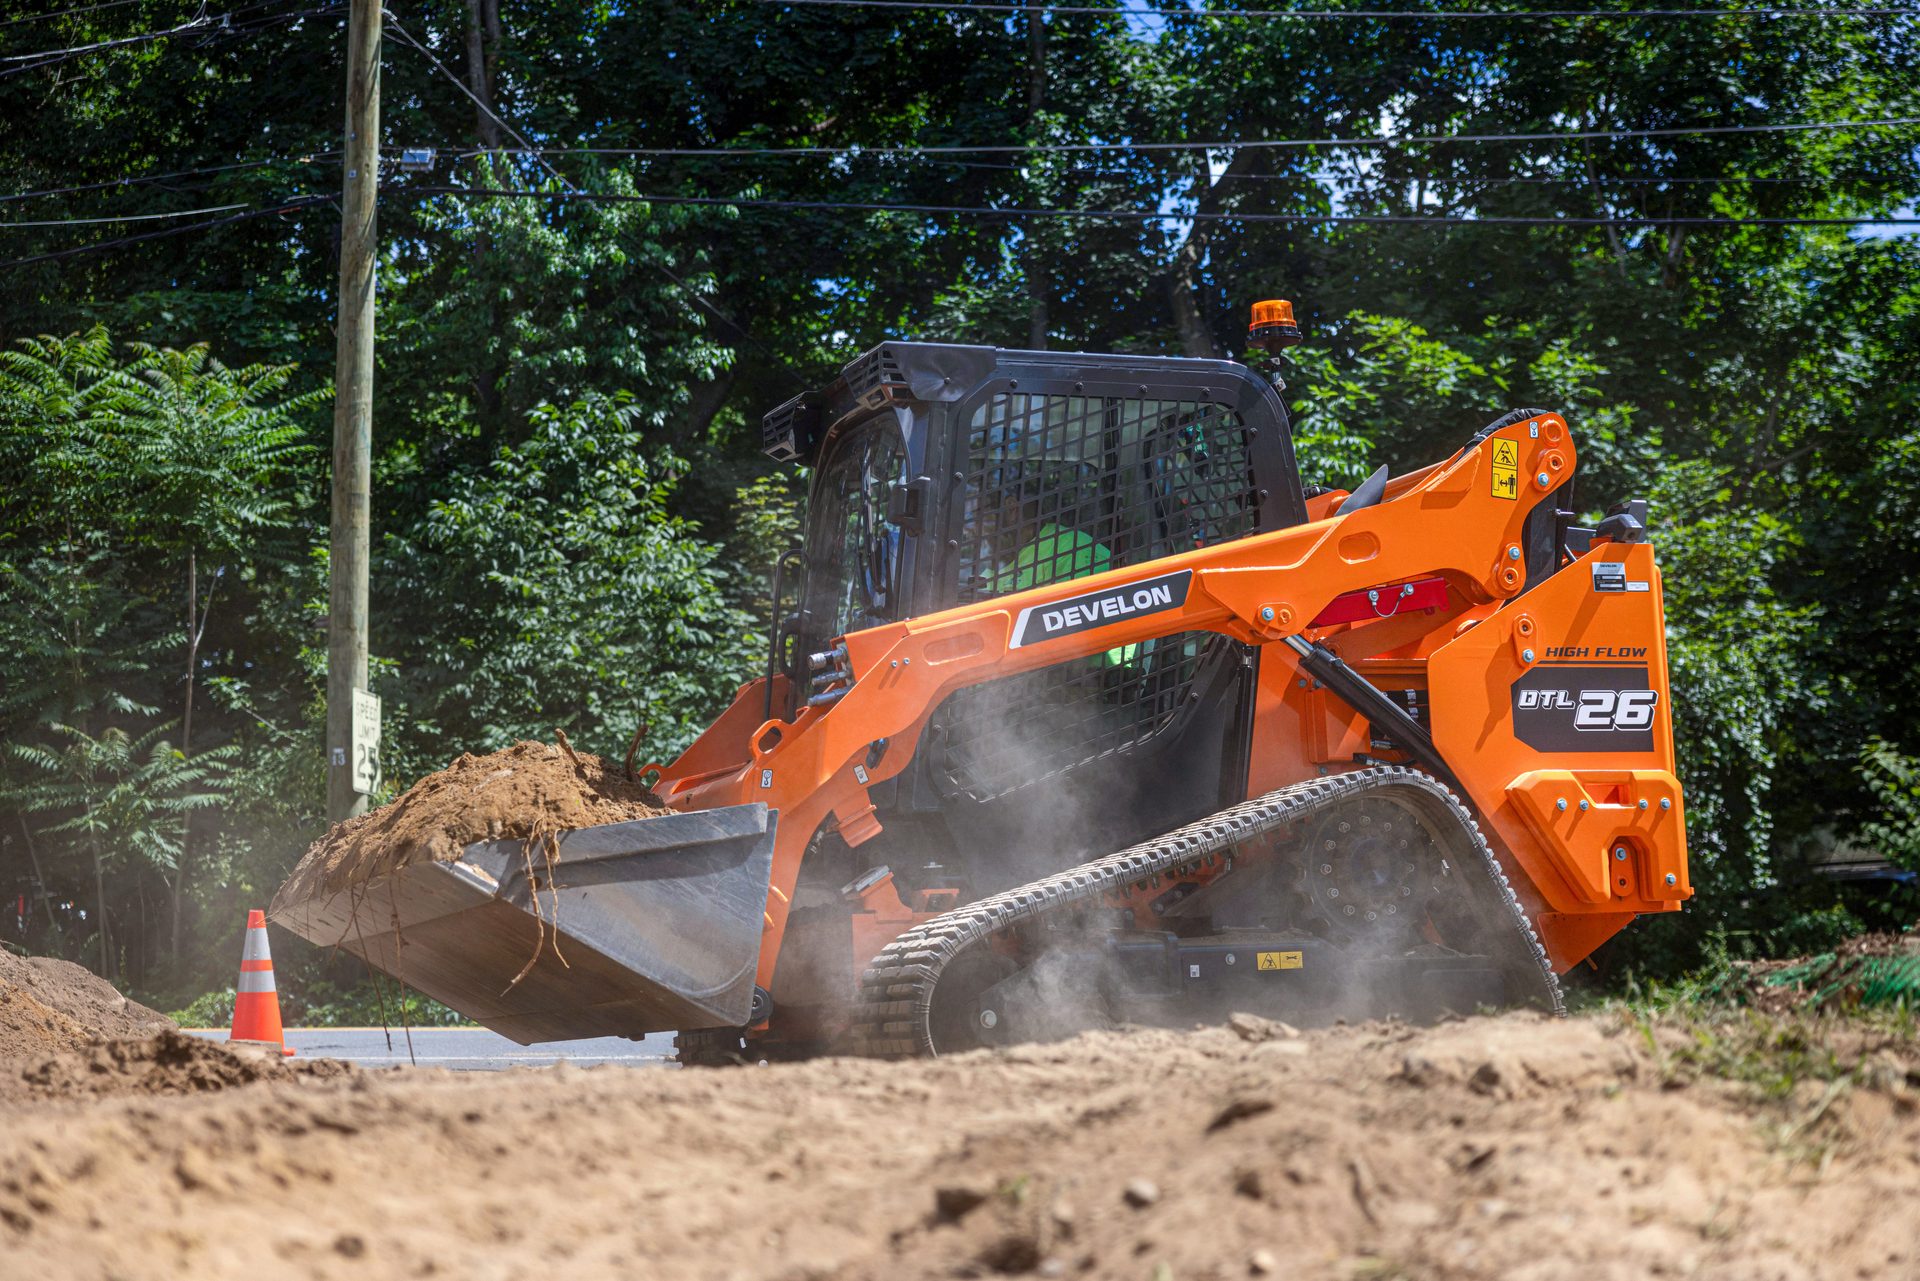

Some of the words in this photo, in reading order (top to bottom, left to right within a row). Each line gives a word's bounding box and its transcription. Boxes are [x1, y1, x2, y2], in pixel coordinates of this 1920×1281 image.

[1042, 584, 1172, 632] DEVELON
[1546, 647, 1589, 657] HIGH
[1595, 647, 1647, 657] FLOW
[358, 722, 376, 738] LIMIT
[1518, 690, 1575, 709] DTL
[1573, 690, 1659, 731] 26
[357, 743, 378, 782] 25
